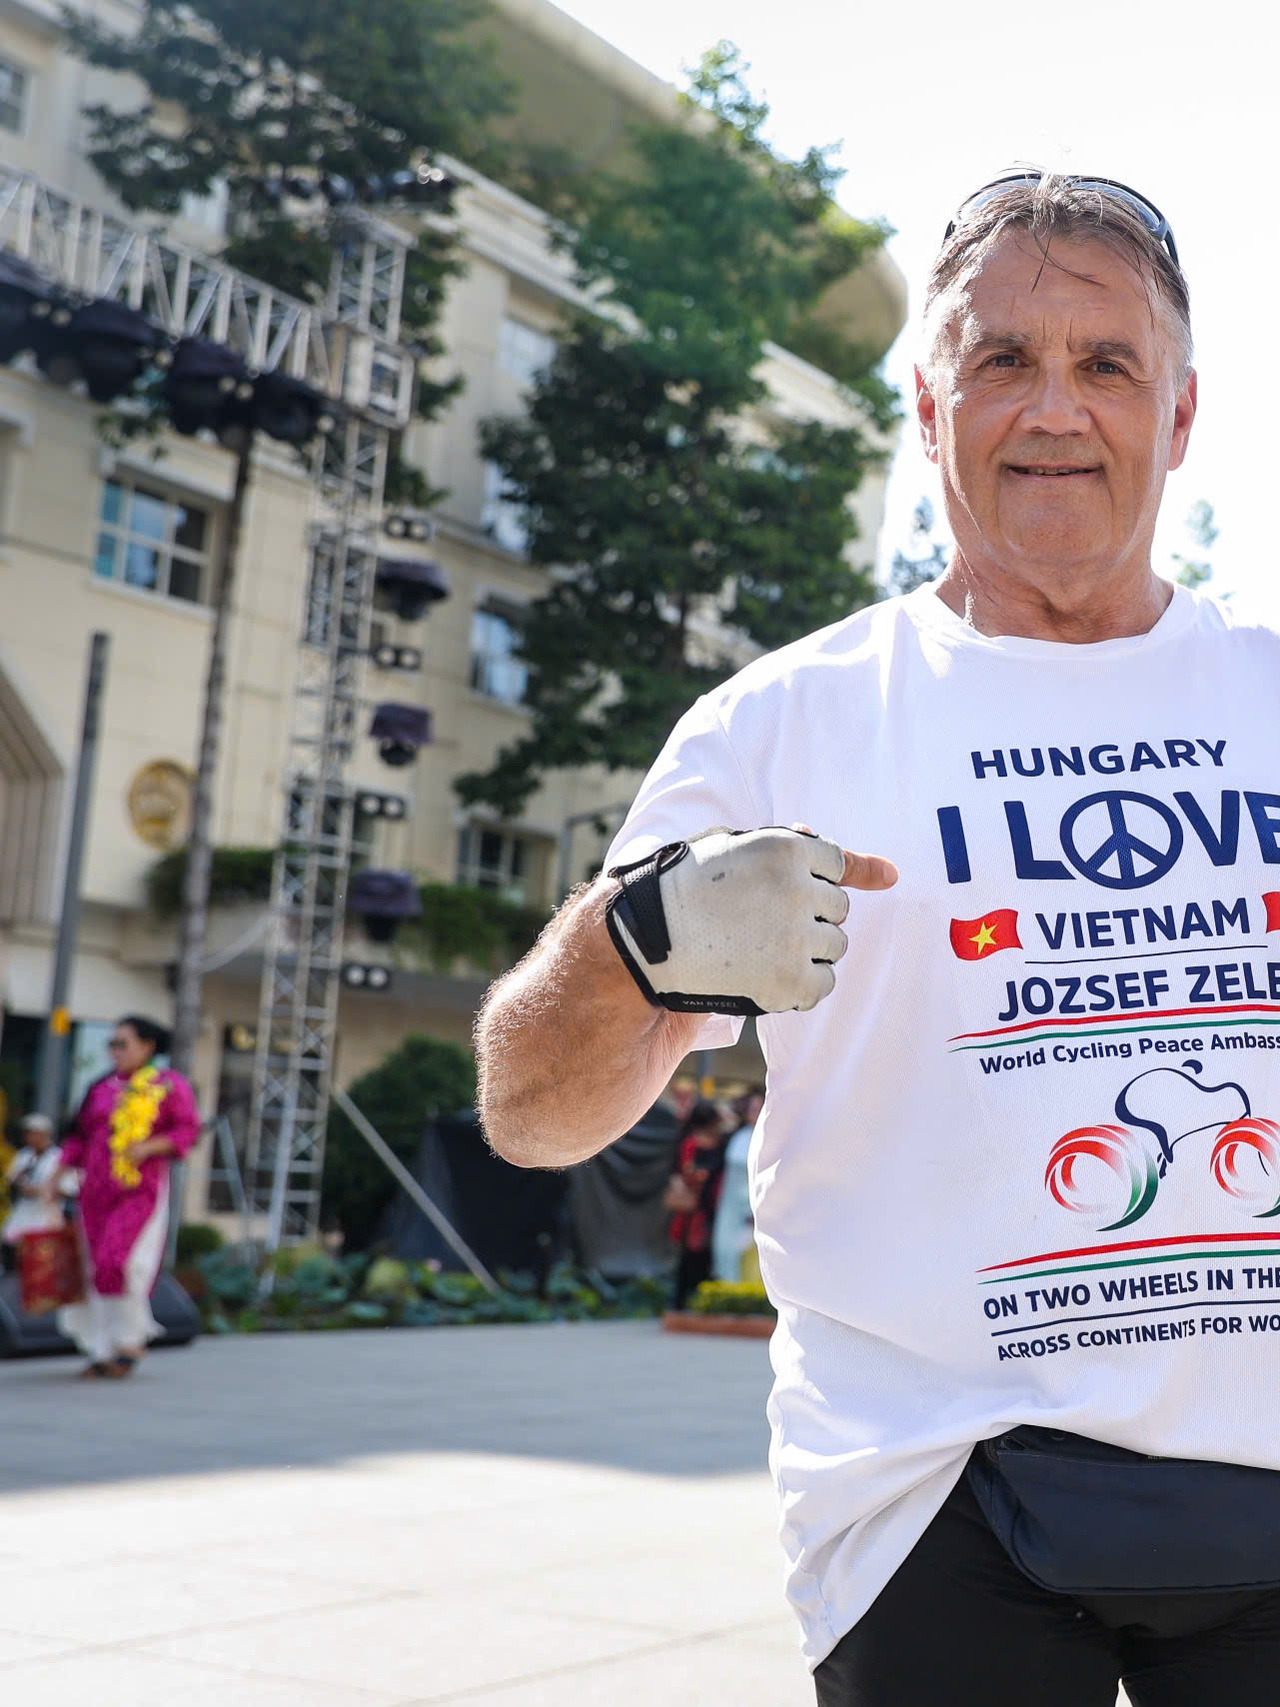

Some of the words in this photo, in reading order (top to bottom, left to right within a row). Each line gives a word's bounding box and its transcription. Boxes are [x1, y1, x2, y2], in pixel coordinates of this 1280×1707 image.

[971, 739, 1227, 780] HUNGARY
[937, 805, 972, 884] I
[1035, 898, 1251, 950] VIETNAM
[998, 969, 1170, 1022] JOZSEF
[979, 1047, 1047, 1075] World
[1053, 1042, 1133, 1066] Cycling
[1139, 1037, 1204, 1056] Peace
[984, 1293, 1018, 1319] ON
[1025, 1283, 1091, 1312] TWO
[1099, 1270, 1199, 1302] WHEELS
[1207, 1269, 1234, 1291] IN
[998, 1334, 1071, 1361] ACROSS
[1077, 1319, 1196, 1348] CONTINENTS
[1201, 1316, 1242, 1334] FOR
